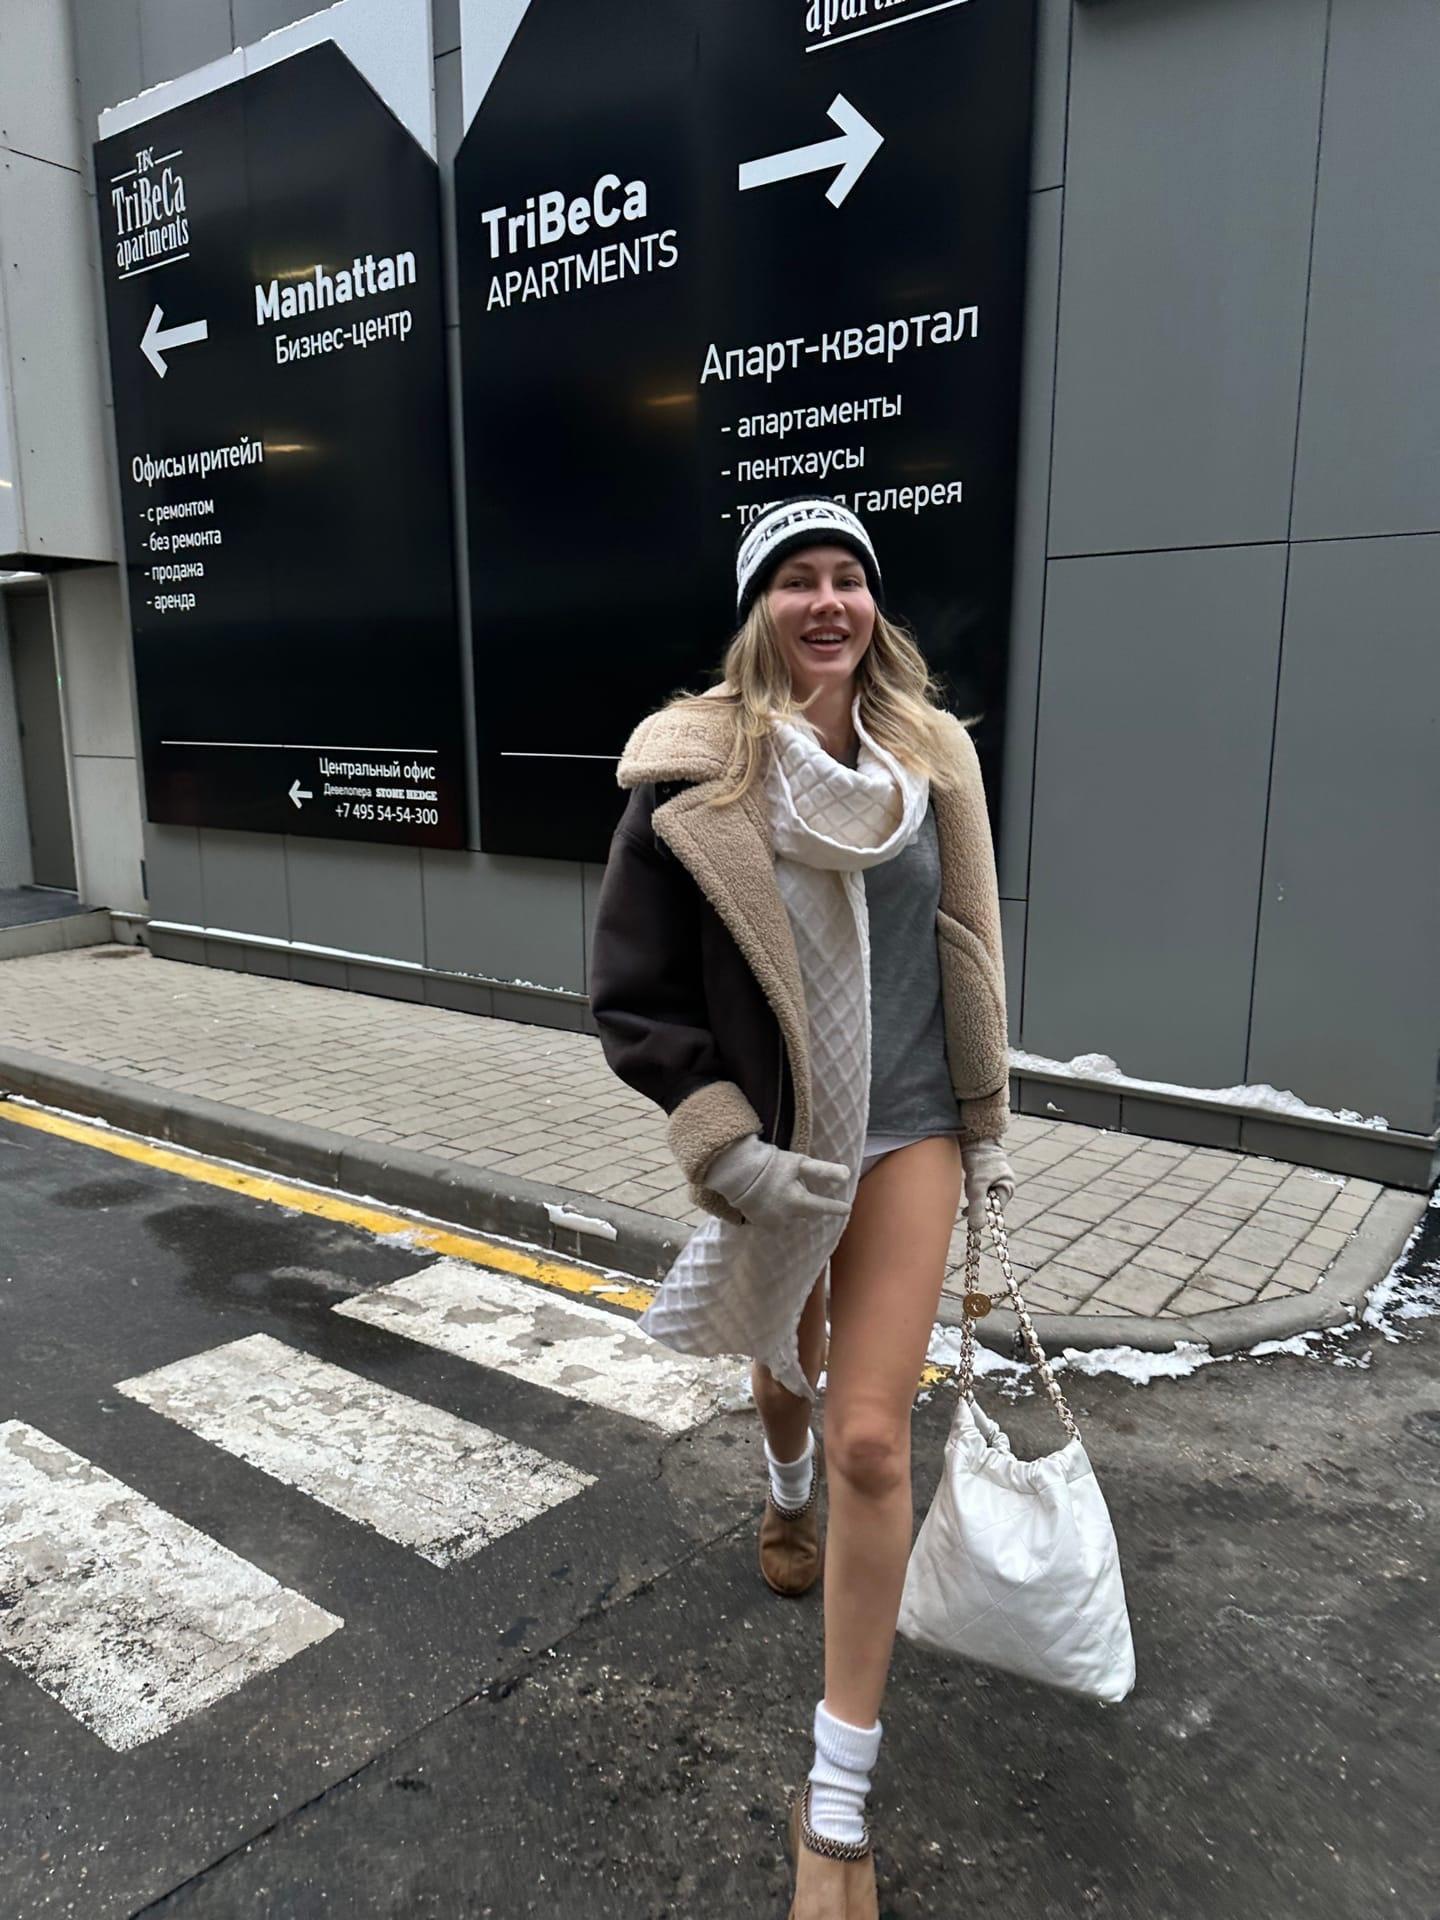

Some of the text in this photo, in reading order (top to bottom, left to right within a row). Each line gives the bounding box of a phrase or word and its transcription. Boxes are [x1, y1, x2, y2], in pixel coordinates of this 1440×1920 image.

[111, 167, 187, 236] TriBeCa
[481, 173, 648, 259] TriBeCa
[116, 216, 190, 271] apartments
[254, 250, 417, 326] Manhattan
[486, 229, 679, 312] APARTMENTS
[275, 310, 412, 364] Бизнес-центр
[700, 305, 979, 384] Апарт-квартал
[738, 394, 902, 440] апартаменты
[132, 436, 263, 488] Офисы и ритейл
[738, 446, 865, 482] пентхаусы
[147, 507, 155, 522] с
[156, 499, 215, 526] ремонтом
[855, 481, 963, 515] галерея
[150, 531, 170, 552] без
[172, 529, 222, 553] ремонта
[152, 562, 205, 585] продажа
[154, 592, 196, 614] аренда
[319, 757, 436, 784] Центральный офис
[335, 802, 439, 825] +7 495 54-54-300
